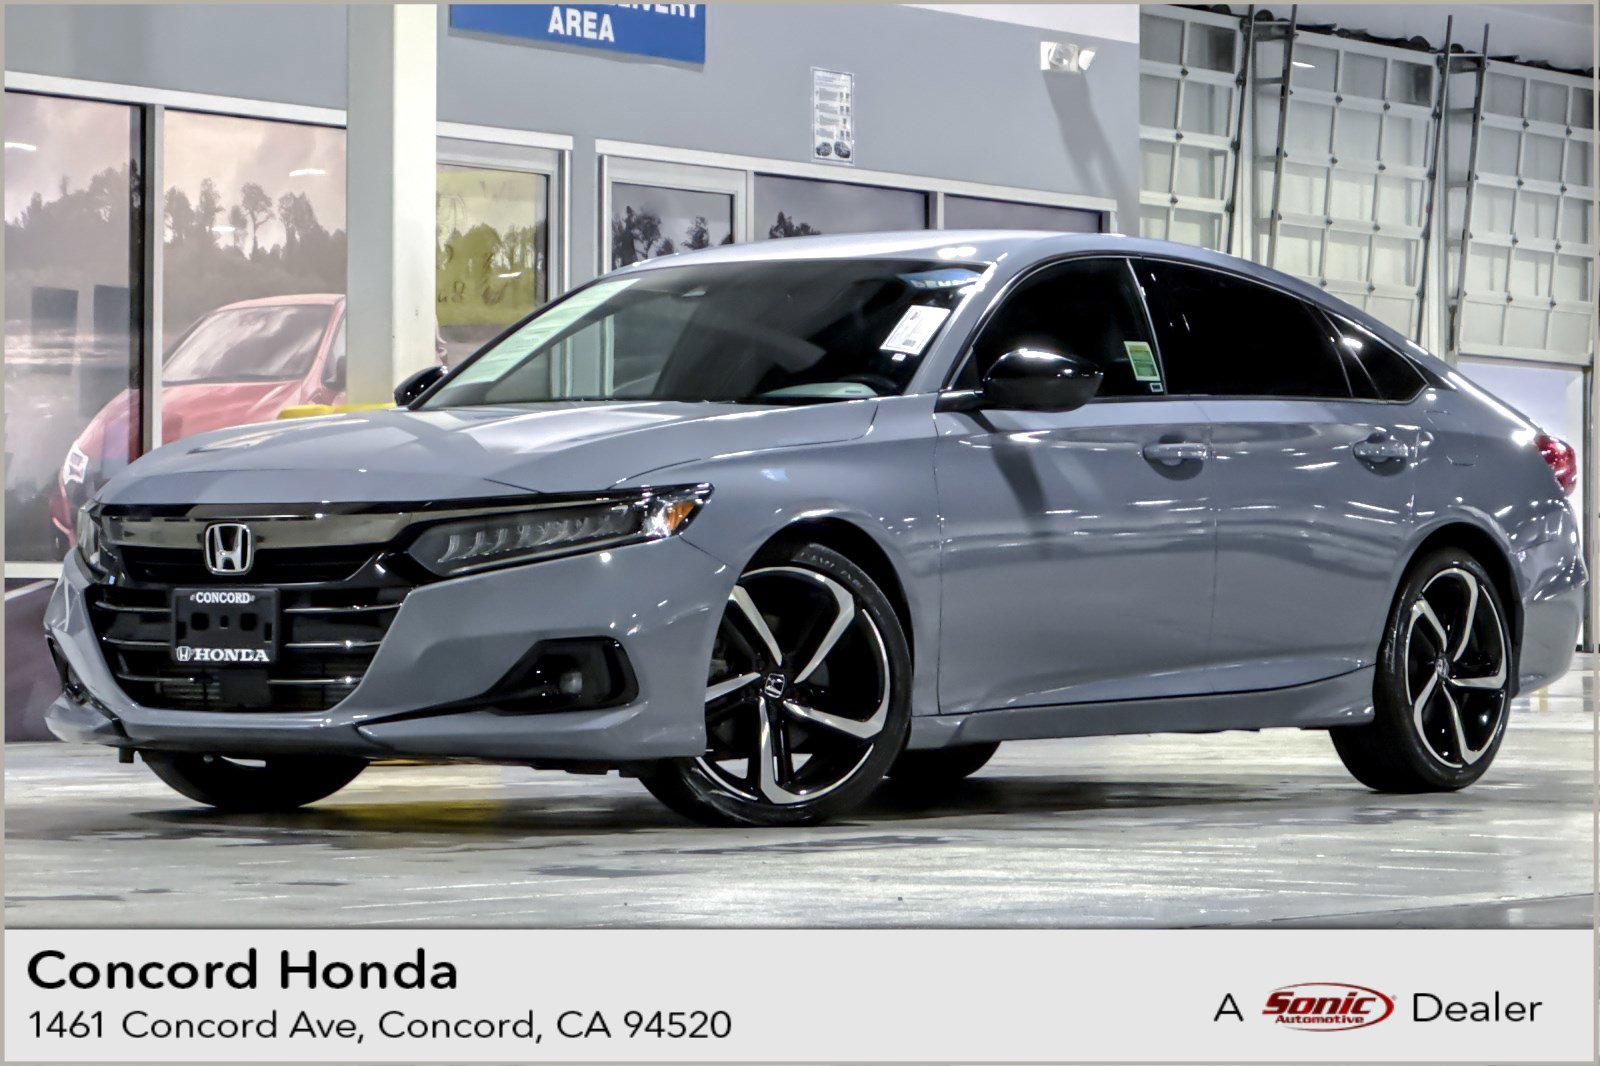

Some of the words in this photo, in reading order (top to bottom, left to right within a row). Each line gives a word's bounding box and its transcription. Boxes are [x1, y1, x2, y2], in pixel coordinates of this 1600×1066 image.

[547, 6, 615, 42] AREA
[196, 592, 250, 604] CONCORD
[194, 648, 270, 662] HONDA
